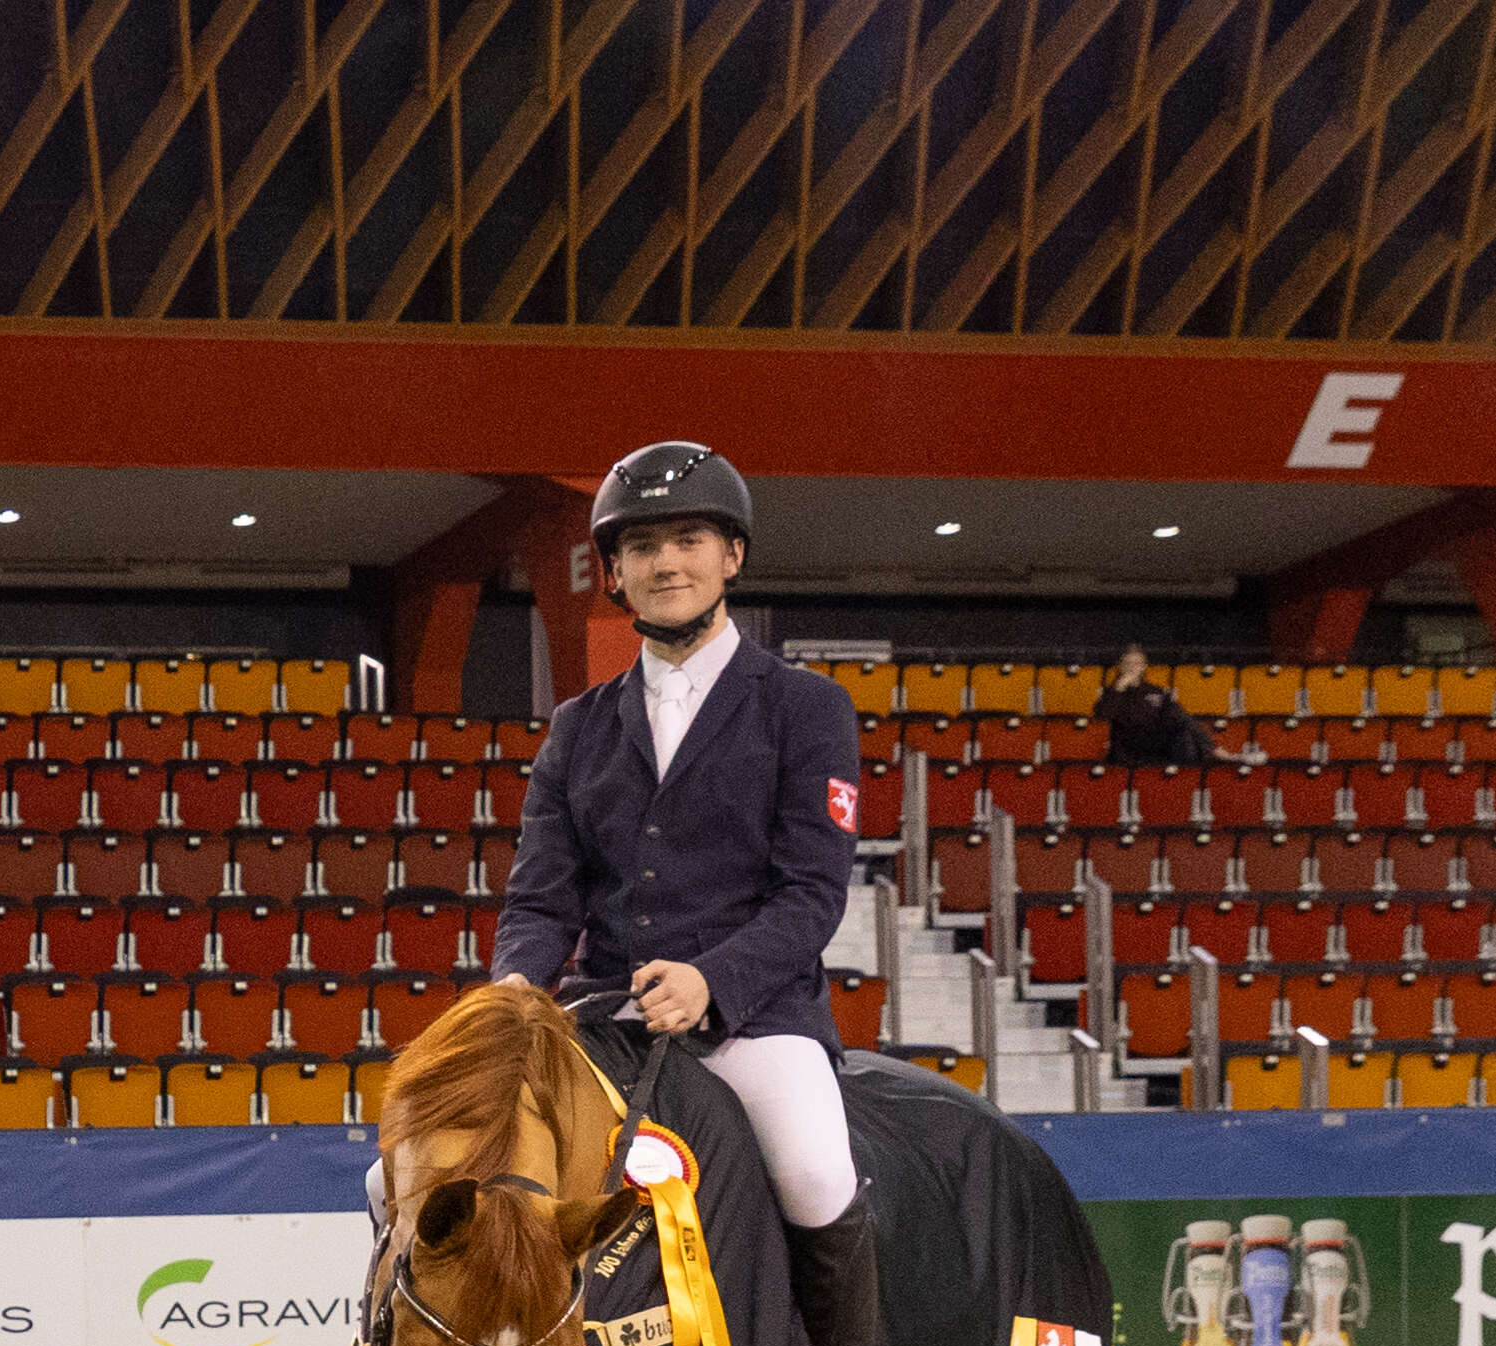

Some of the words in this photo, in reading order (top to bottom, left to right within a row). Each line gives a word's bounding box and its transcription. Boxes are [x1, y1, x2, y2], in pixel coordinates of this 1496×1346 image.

[1284, 372, 1405, 469] E
[570, 542, 593, 593] E
[593, 1255, 622, 1279] 100
[159, 1297, 362, 1330] AGRAVI
